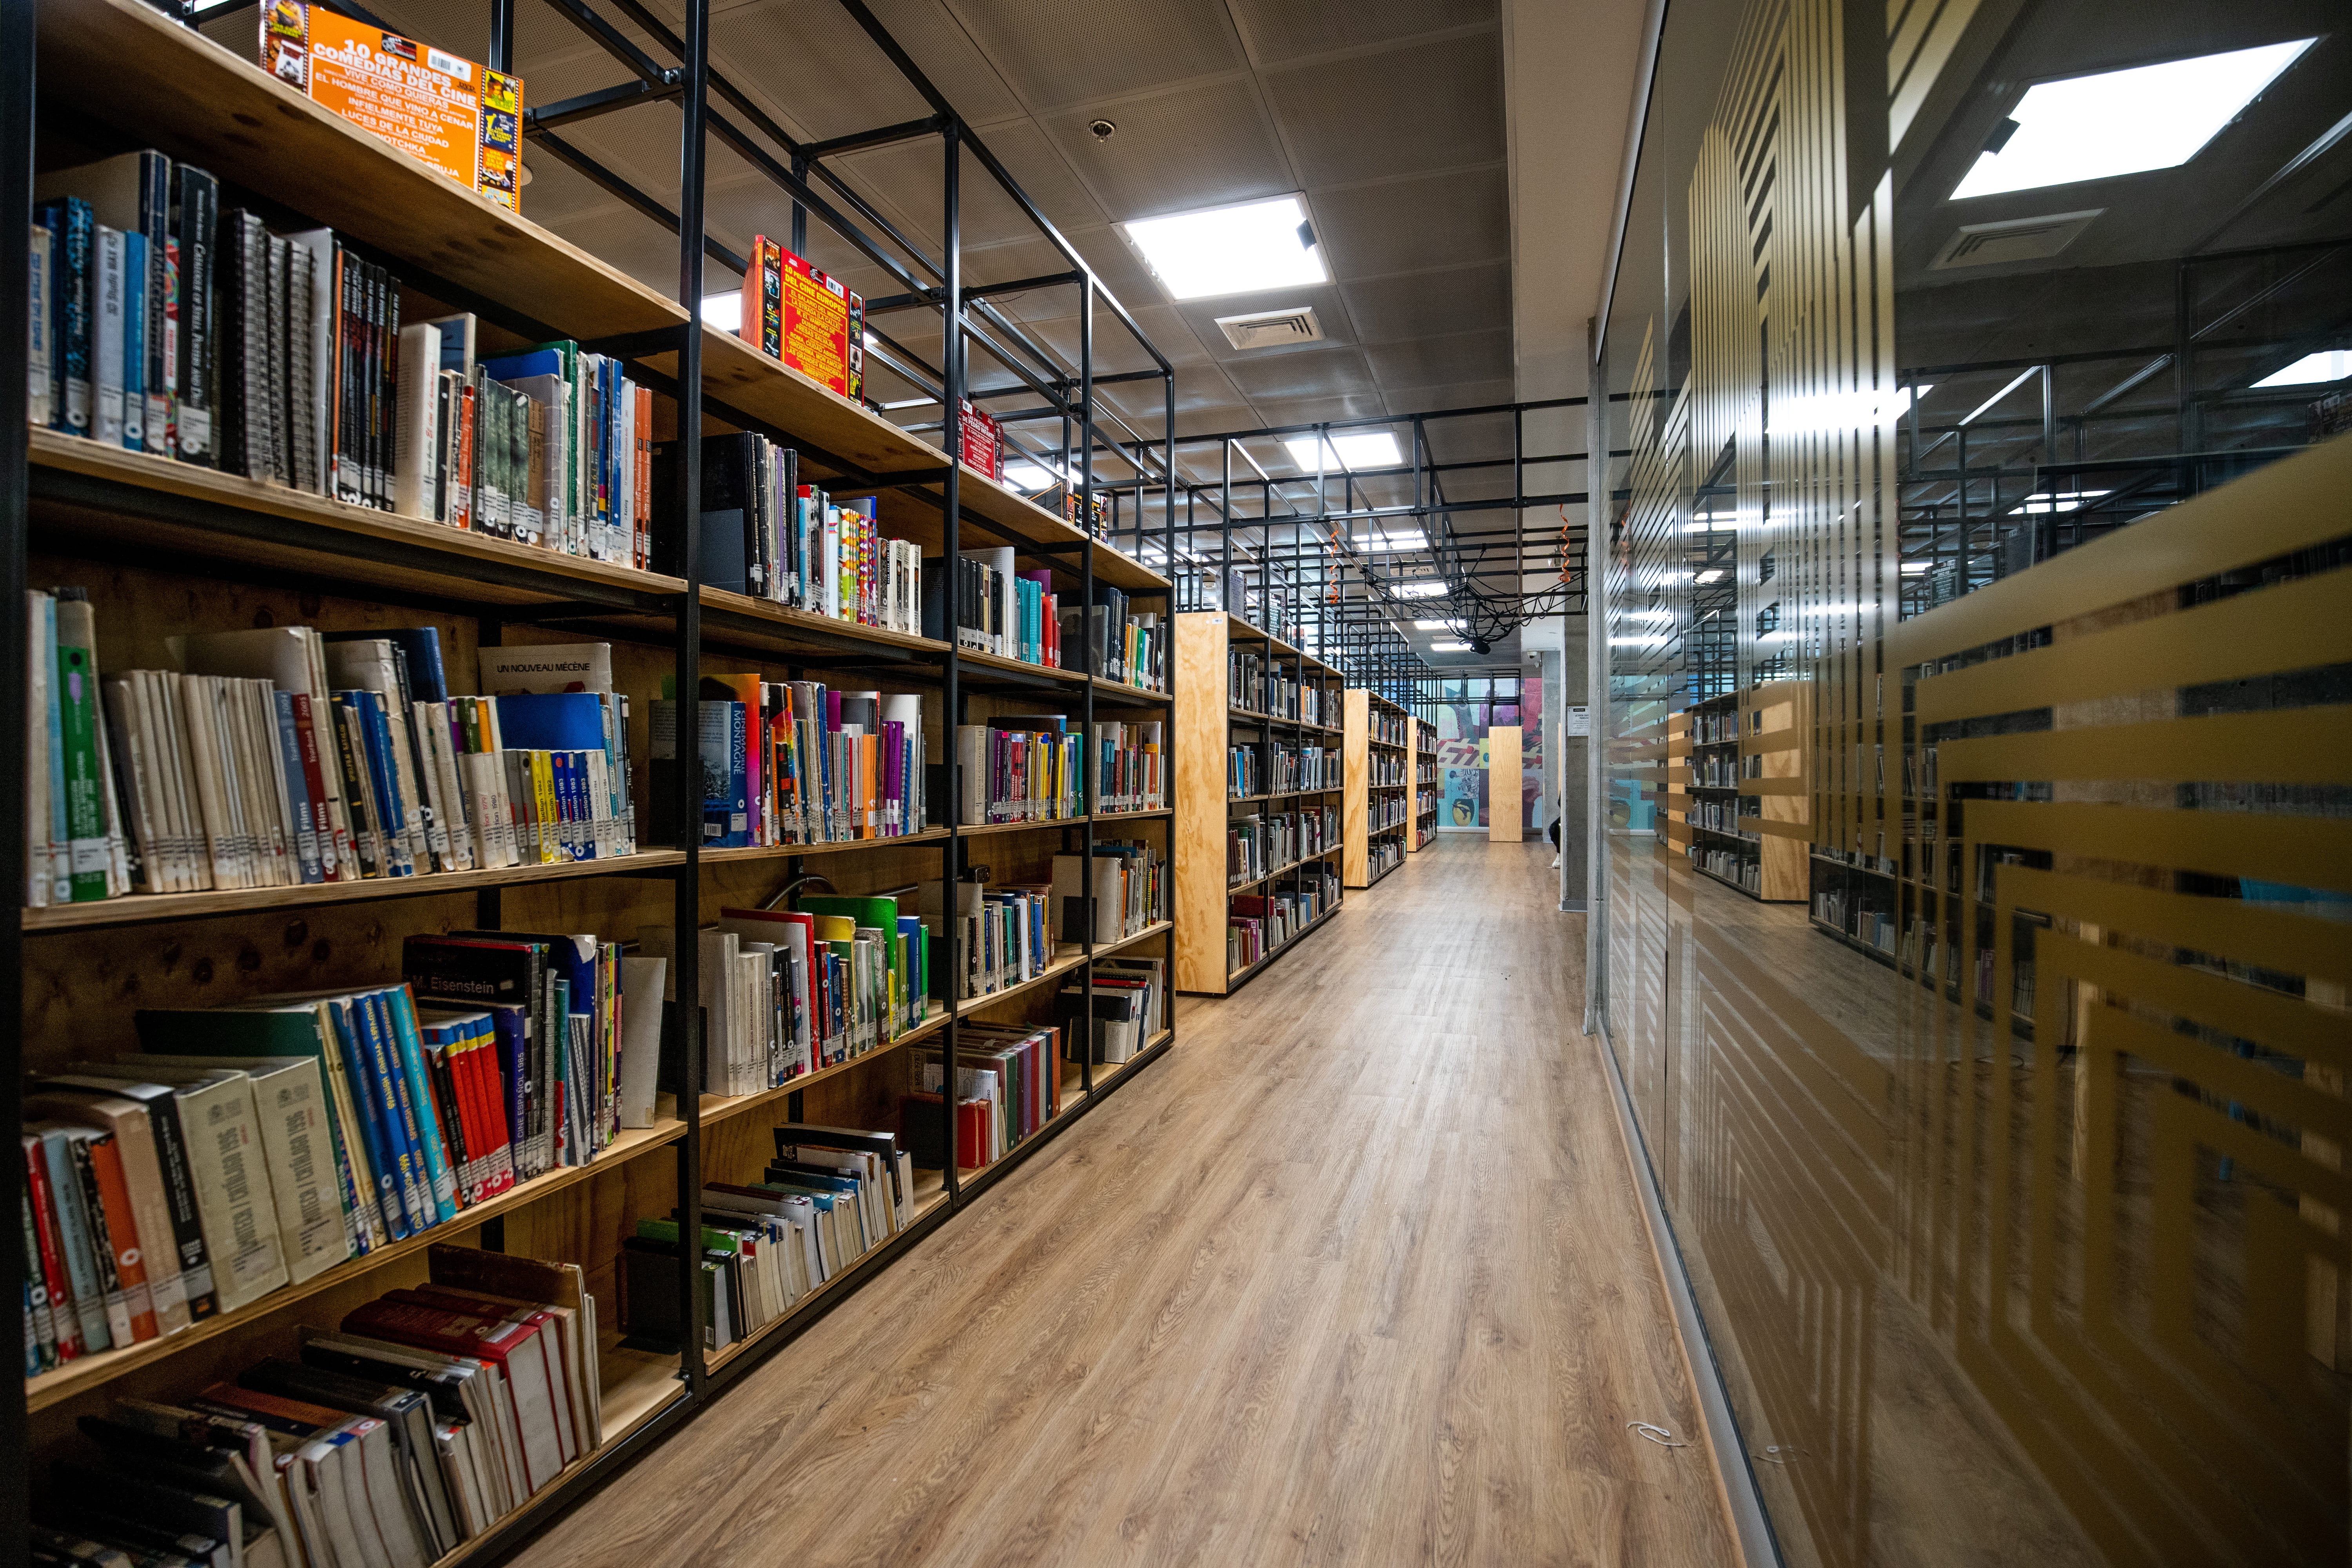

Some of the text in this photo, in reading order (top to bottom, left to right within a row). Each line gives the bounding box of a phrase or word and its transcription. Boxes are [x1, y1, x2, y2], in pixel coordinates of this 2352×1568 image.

[314, 43, 402, 82] COMEDIAS
[407, 74, 437, 94] DEL
[440, 87, 477, 107] CINE
[344, 39, 452, 87] 10 GRANDES
[315, 72, 329, 83] EL
[332, 77, 377, 98] HOMBRE
[380, 94, 402, 107] QUE
[405, 101, 429, 116] VINO
[430, 111, 438, 120] A
[440, 113, 474, 131] CENAR
[344, 68, 368, 82] VIVE
[370, 78, 402, 93] COMO
[404, 89, 449, 109] QUIERAS
[341, 108, 377, 126] LUCES
[379, 120, 393, 131] DE
[396, 125, 410, 136] LA
[411, 131, 449, 148] CIUDAD
[348, 96, 416, 125] INFIELMENTE
[418, 119, 444, 134] TUYA
[486, 153, 504, 162] NOCHE
[784, 265, 846, 307] 10 PELÍCULAS INMORTALES
[785, 273, 798, 287] DEL
[799, 282, 815, 297] CINE
[817, 292, 846, 315] EUROPEO
[798, 294, 817, 308] SALARIO
[818, 305, 826, 314] DEL
[827, 310, 841, 322] MIEDO
[799, 302, 817, 317] STRADA
[825, 318, 840, 330] CALLE)
[809, 316, 829, 331] VAMPIRO
[796, 324, 814, 338] FRESAS
[815, 334, 836, 349] SALVAJES
[802, 318, 831, 338] DUSSELDORF
[786, 346, 796, 356] LAS
[796, 352, 818, 367] GRANDES
[819, 363, 844, 380] MANIOBRAS
[789, 339, 842, 371] HIROSHIMA, MON AMOUR
[790, 332, 805, 344] ROMA,
[806, 340, 822, 353] CIUDAD
[823, 349, 841, 363] ABIERTA
[803, 366, 825, 380] UMBERTO
[968, 418, 980, 430] PEDRO
[981, 427, 995, 440] INFANTE
[981, 435, 991, 445] POLLERO
[968, 458, 979, 468] ESCUELA
[973, 454, 986, 464] REPORTAJE
[982, 444, 992, 453] CUIDADO
[590, 468, 598, 501] 1987
[512, 664, 554, 673] NOUVEAU
[555, 662, 590, 671] MÉCÈNE
[287, 728, 299, 761] Yearbook
[298, 696, 330, 830] Films Yearbook 2005
[299, 802, 312, 830] Films
[431, 977, 494, 995] Eisenstein
[374, 1042, 387, 1074] CINEMA
[382, 1076, 396, 1110] SPANISH
[516, 1074, 524, 1116] ESPAÑOL
[405, 1108, 418, 1141] SPANISH
